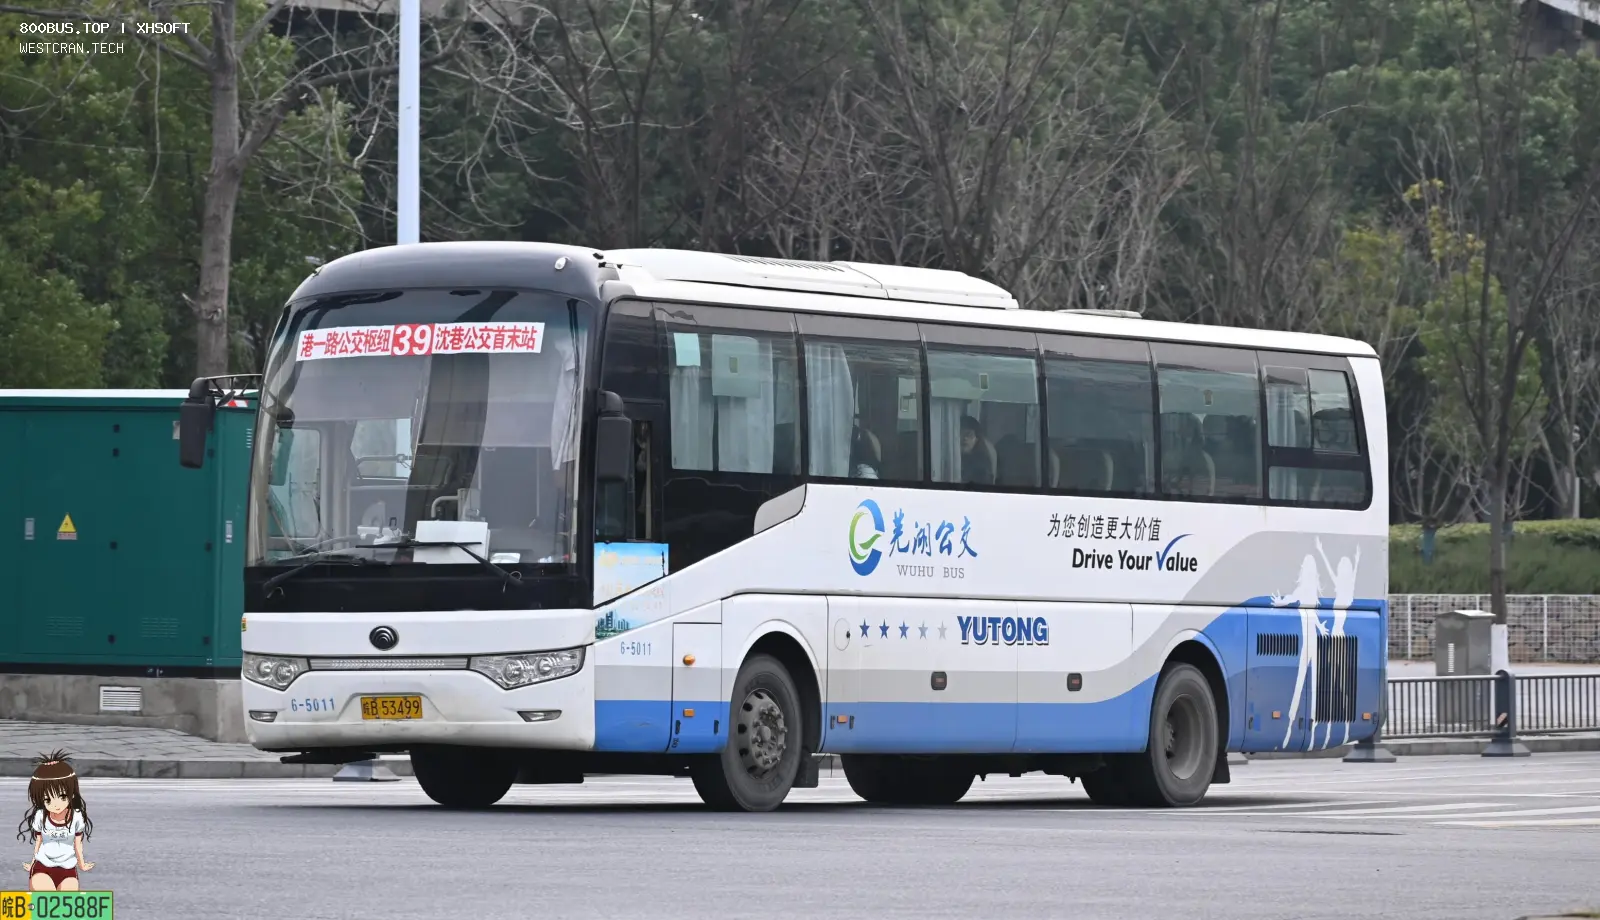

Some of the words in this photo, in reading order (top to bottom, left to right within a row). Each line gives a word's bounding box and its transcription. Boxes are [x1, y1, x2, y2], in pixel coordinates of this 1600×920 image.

[300, 328, 390, 358] 港一路公交枢纽
[392, 325, 432, 355] 39
[435, 325, 537, 351] 沈巷公交首末站
[888, 507, 978, 559] 芜湖公交
[1047, 512, 1162, 541] 为您创造更大价值
[1072, 548, 1113, 571] Drive
[1118, 549, 1153, 571] Your
[1156, 534, 1198, 573] Value
[896, 564, 934, 578] WUHU
[943, 566, 965, 579] BUS
[956, 615, 1050, 646] YUTONG
[620, 641, 652, 656] 6-5011
[290, 697, 336, 713] 6-5011
